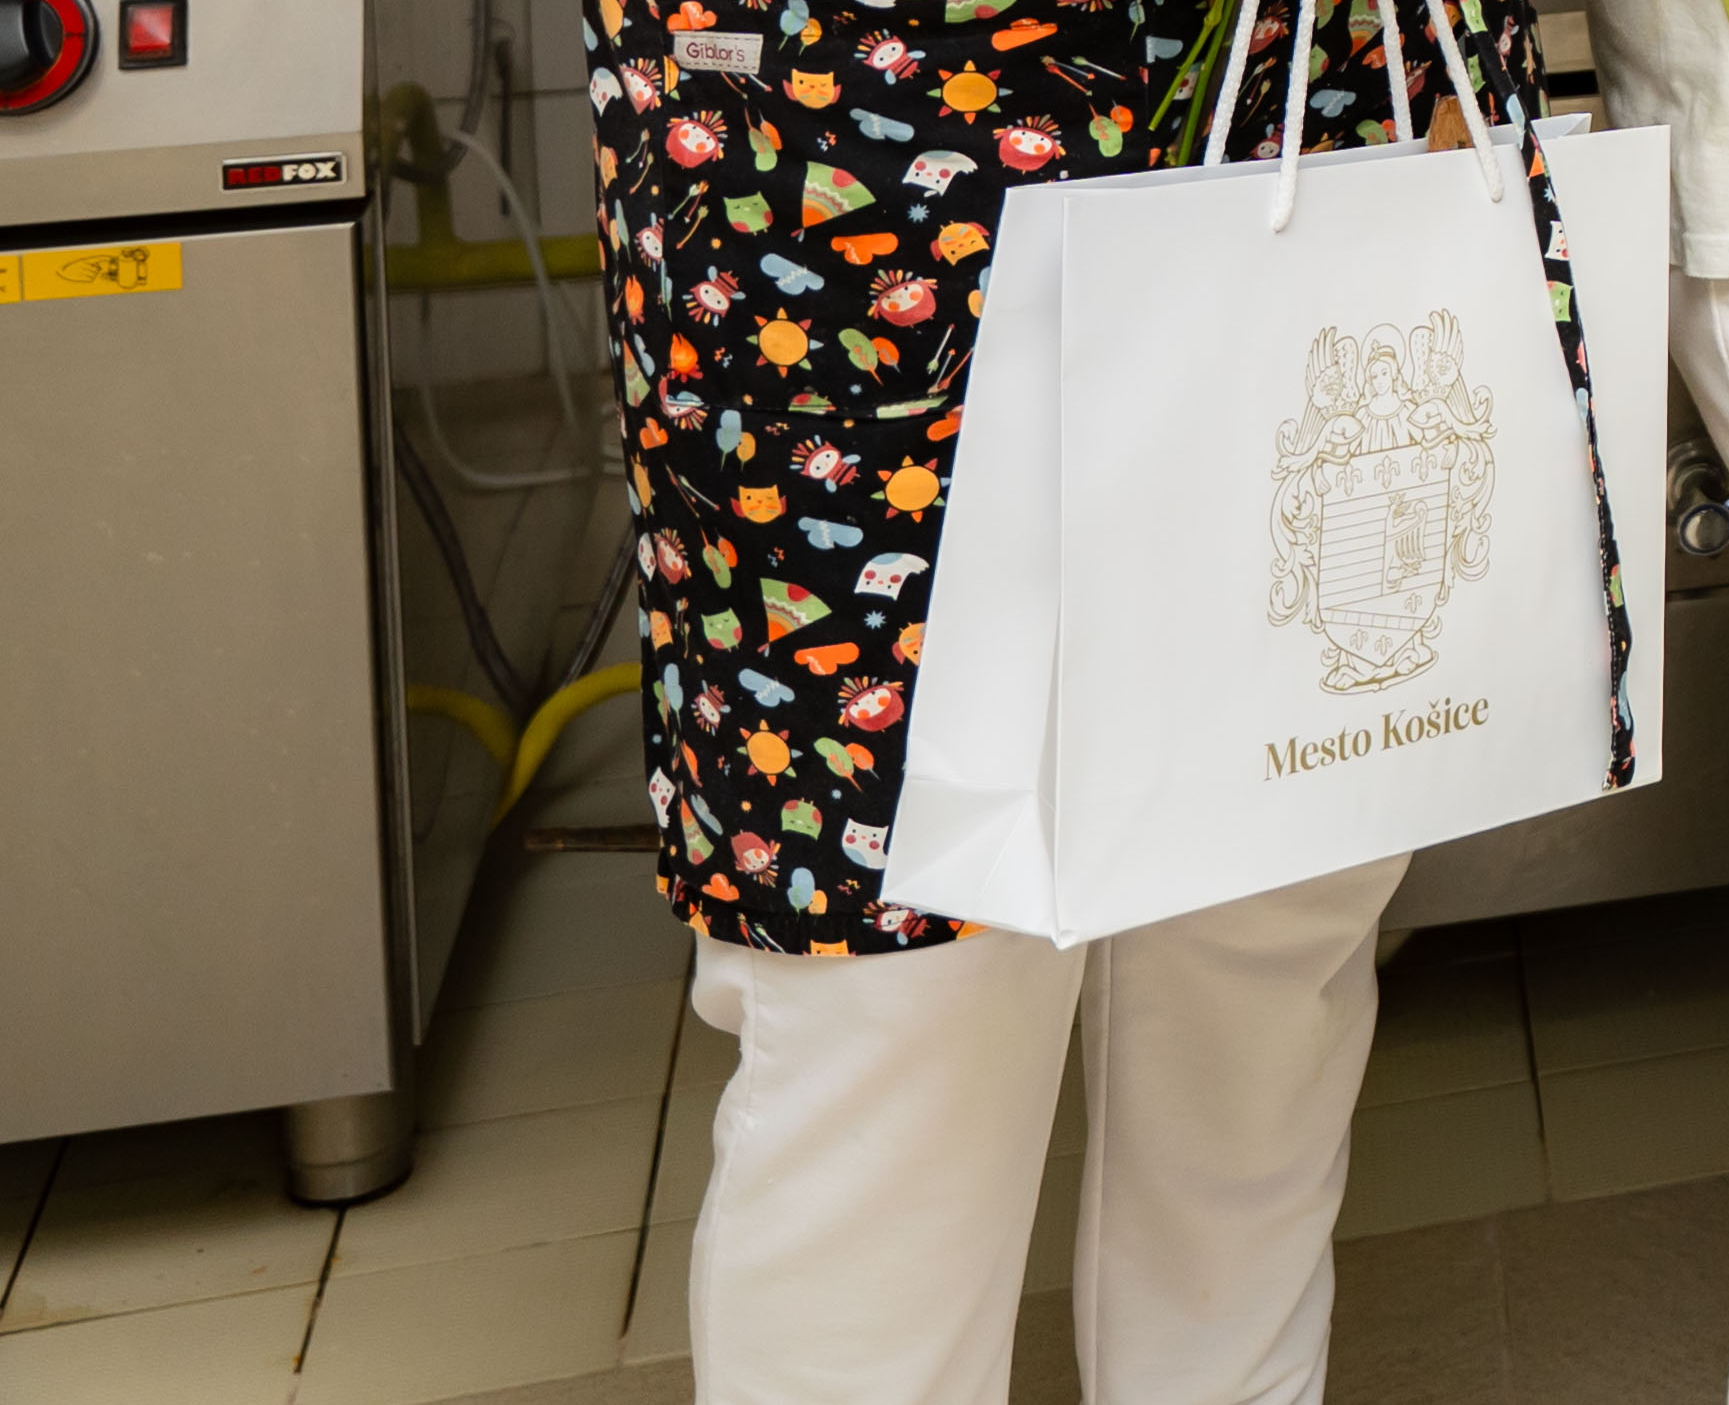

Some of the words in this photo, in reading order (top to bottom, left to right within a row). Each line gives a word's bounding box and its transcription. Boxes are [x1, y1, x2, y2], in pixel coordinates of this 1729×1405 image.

[686, 42, 745, 62] Giblor's
[1263, 726, 1372, 782] Mesto
[1381, 696, 1489, 751] Košice
